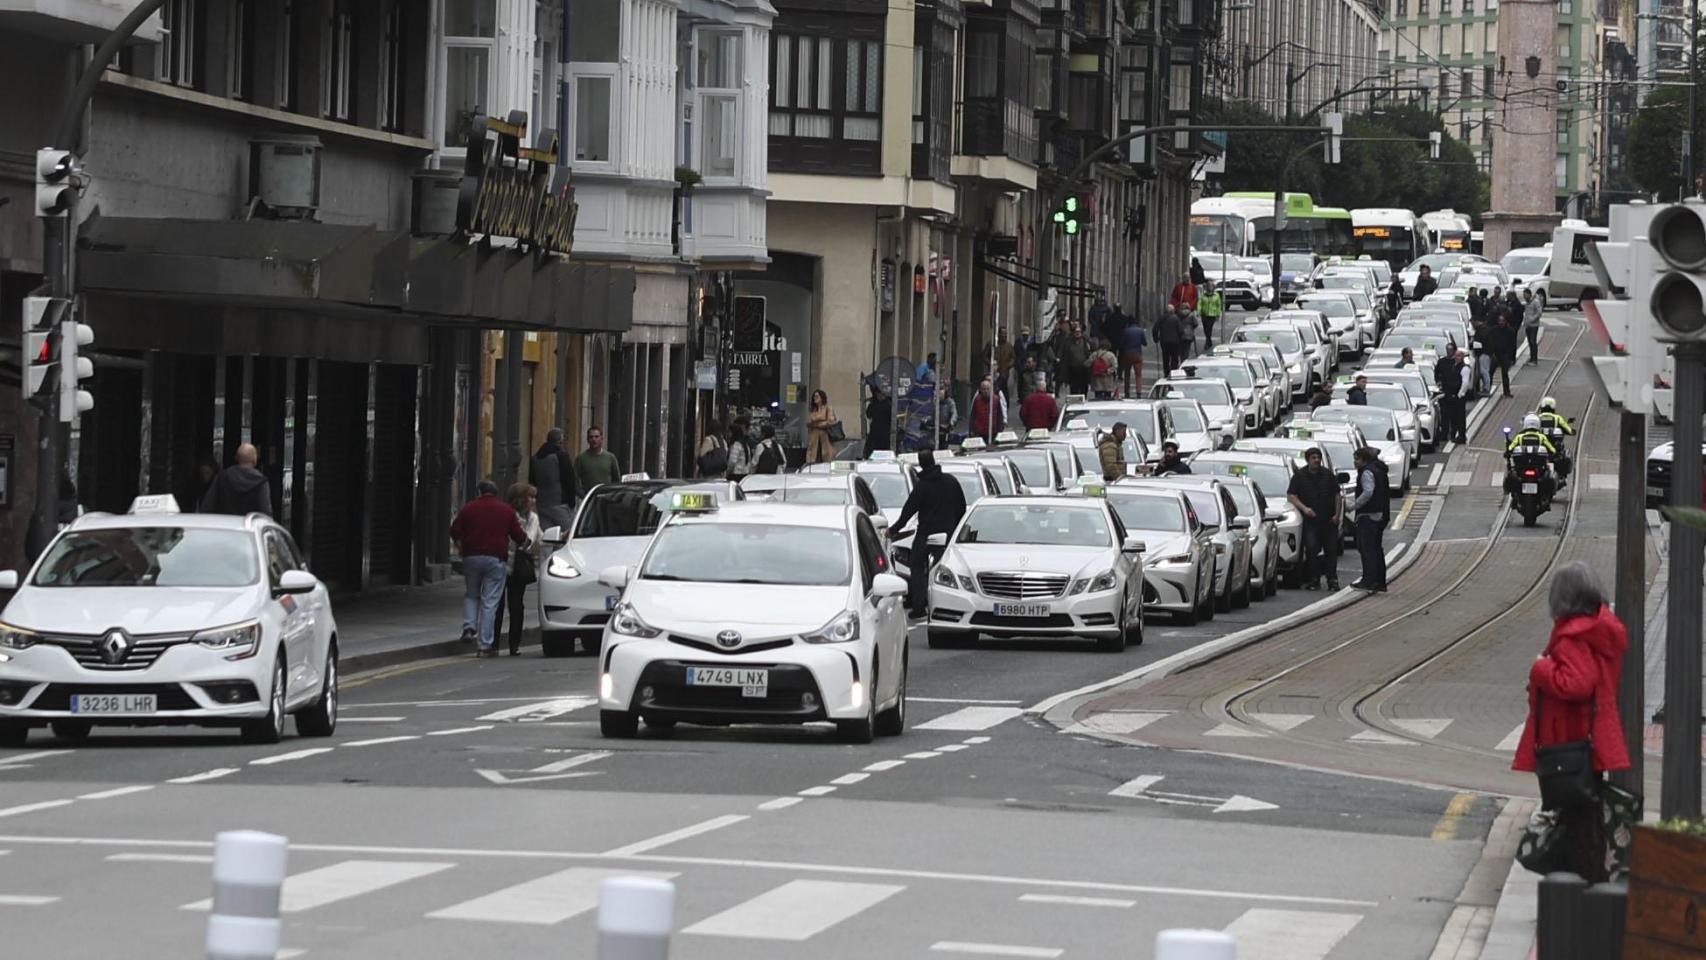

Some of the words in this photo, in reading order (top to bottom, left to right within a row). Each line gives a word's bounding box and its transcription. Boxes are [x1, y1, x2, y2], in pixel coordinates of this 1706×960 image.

[682, 494, 702, 505] TAXI
[1000, 604, 1026, 615] 6980
[1028, 604, 1048, 616] HTP
[696, 669, 733, 685] 4749
[737, 671, 765, 686] LNX
[81, 696, 120, 712] 3236
[124, 696, 153, 712] LHR
